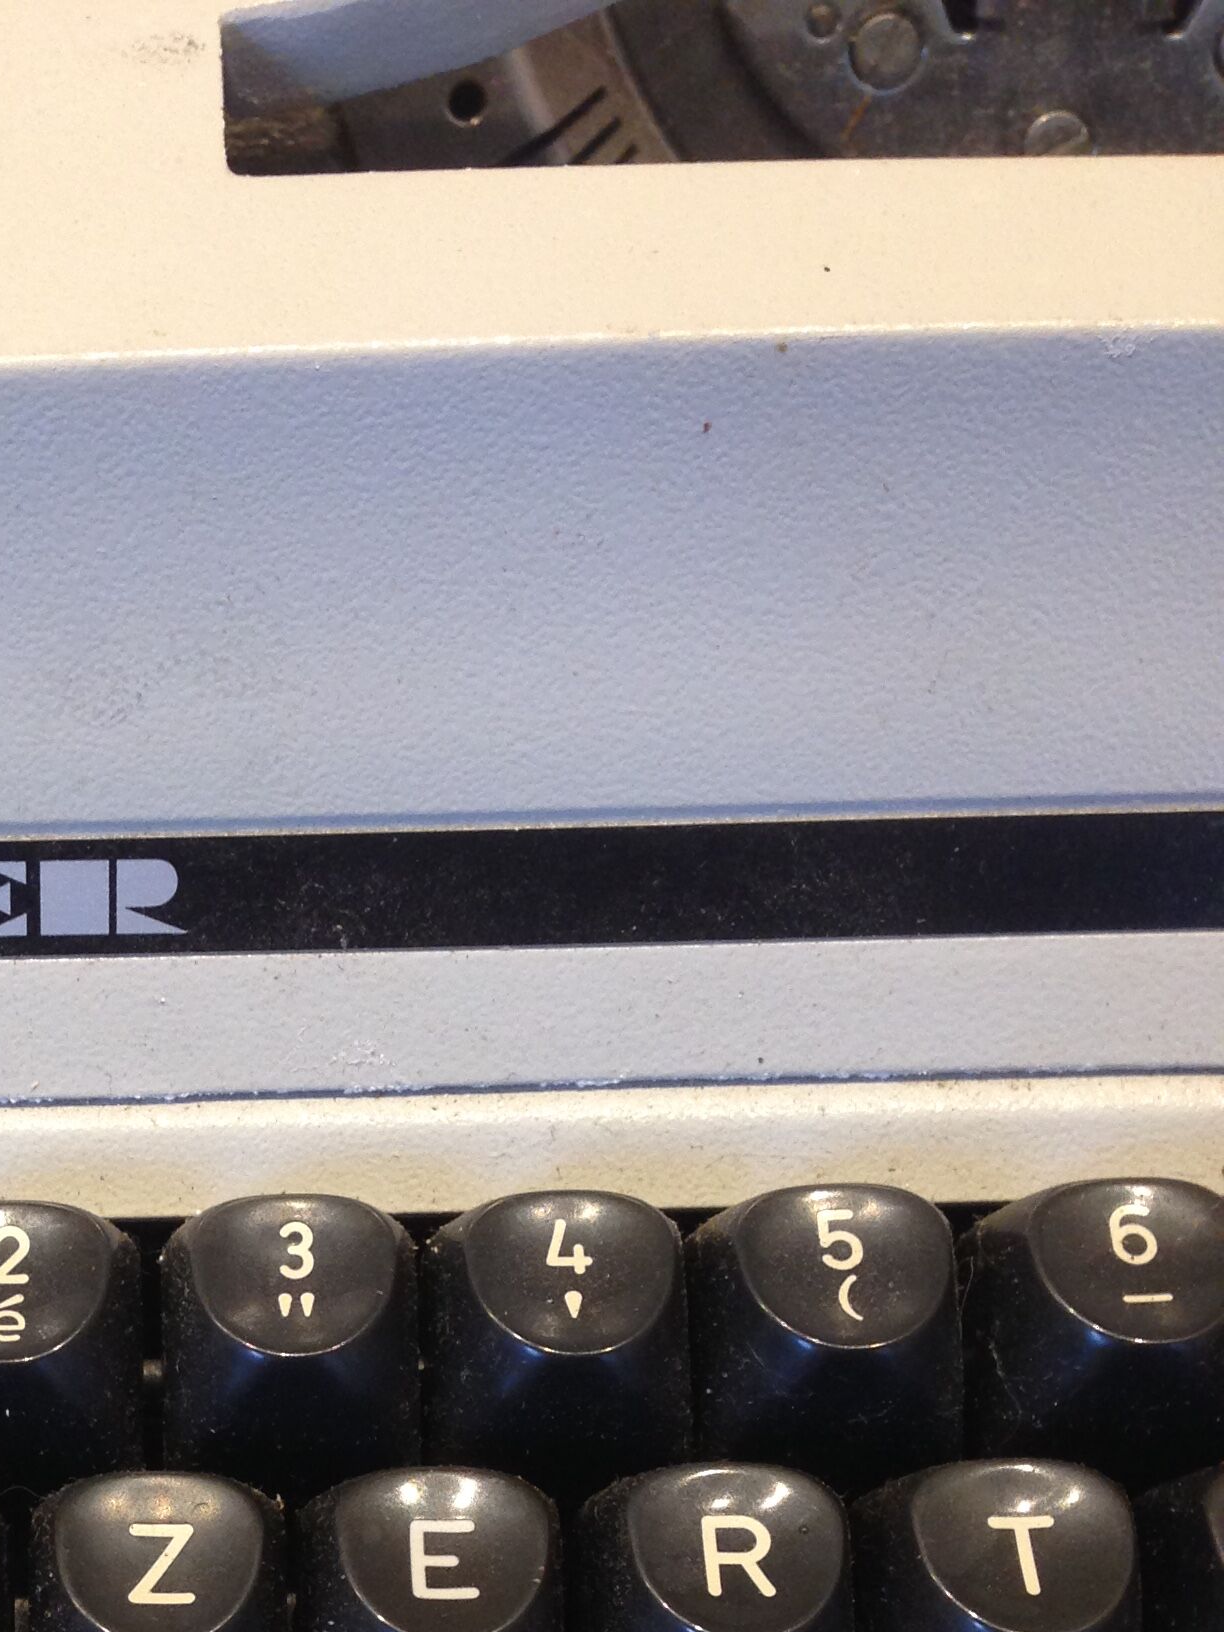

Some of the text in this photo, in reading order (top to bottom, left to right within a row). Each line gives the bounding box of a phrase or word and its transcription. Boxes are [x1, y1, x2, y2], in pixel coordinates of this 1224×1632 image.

[279, 1222, 314, 1279] 3
[545, 1220, 592, 1274] 4
[816, 1209, 863, 1270] 5
[1108, 1204, 1158, 1265] 6
[839, 1274, 864, 1321] (
[127, 1523, 196, 1604] Z
[409, 1519, 480, 1600] E
[701, 1515, 777, 1597] R
[988, 1515, 1054, 1596] T
